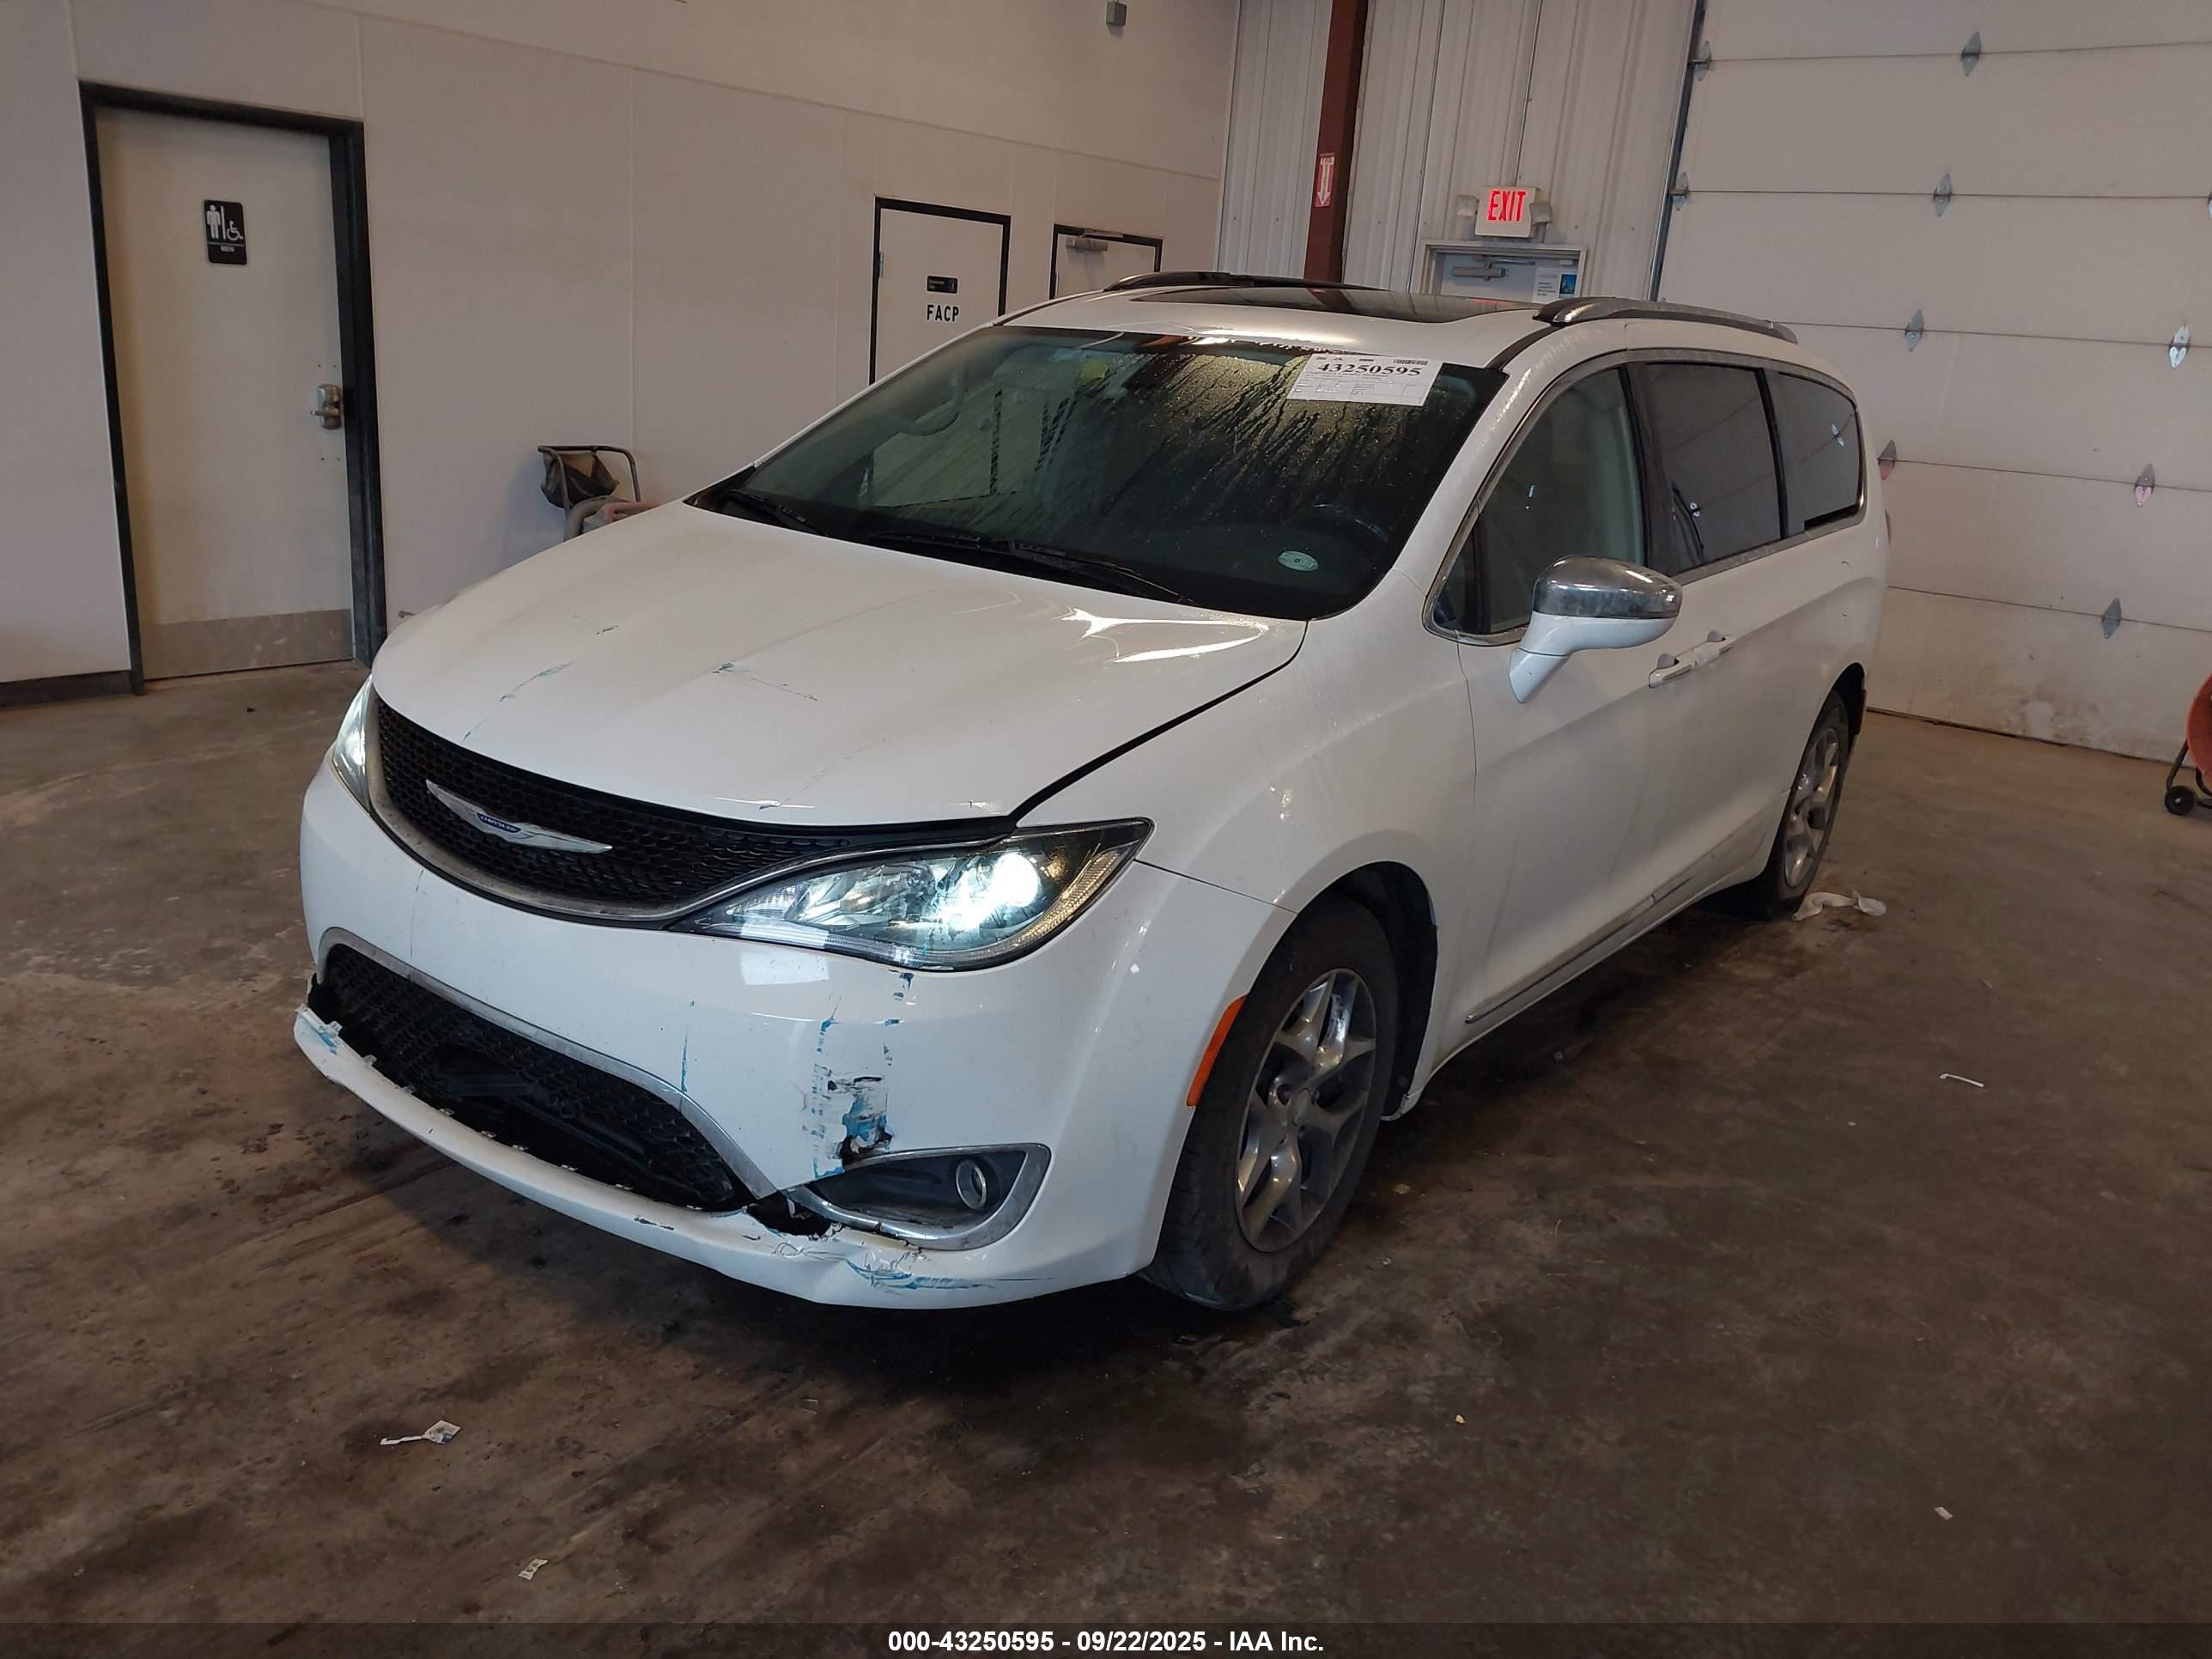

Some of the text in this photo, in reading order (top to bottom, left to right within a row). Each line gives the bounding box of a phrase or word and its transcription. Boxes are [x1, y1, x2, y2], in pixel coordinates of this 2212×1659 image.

[1488, 191, 1526, 221] EXIT
[927, 305, 959, 322] FACP
[1317, 363, 1423, 376] 43250595
